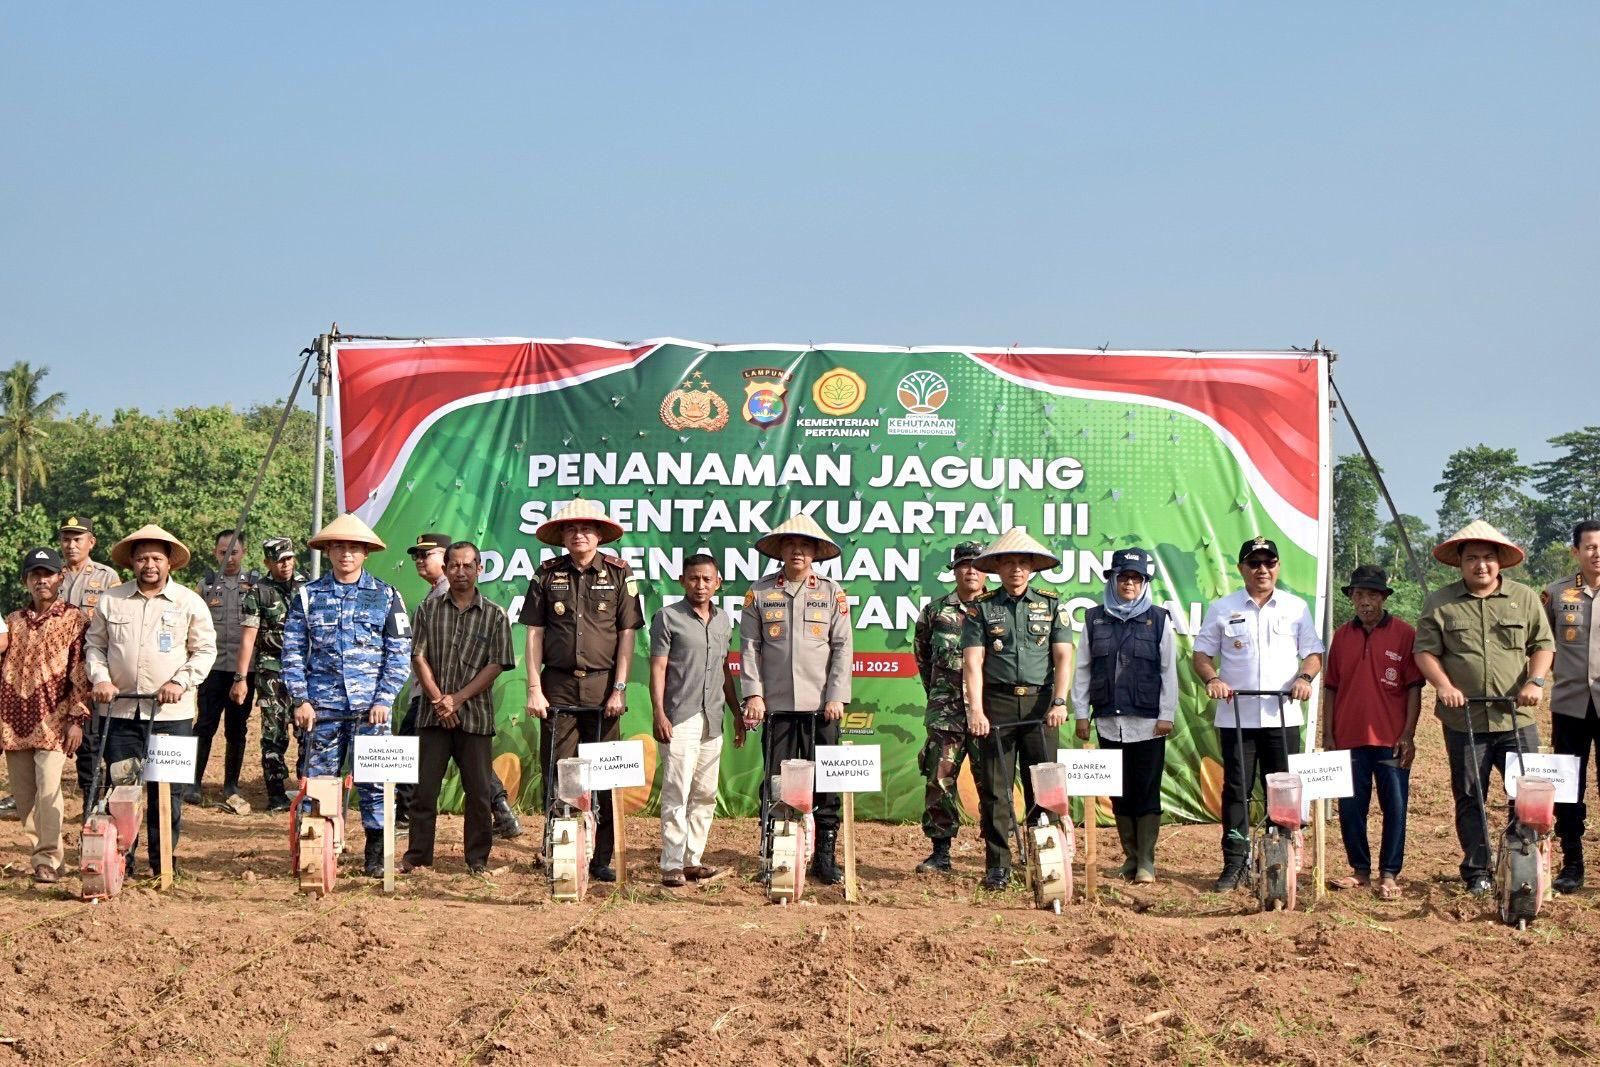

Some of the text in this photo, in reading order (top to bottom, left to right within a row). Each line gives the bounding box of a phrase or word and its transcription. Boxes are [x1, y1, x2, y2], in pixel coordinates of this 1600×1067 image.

[744, 369, 789, 380] LAMPUN
[796, 418, 879, 427] KEMENTERIAN
[889, 419, 954, 428] KEHUTANAN
[804, 428, 870, 437] PERTANIAN
[527, 452, 1084, 490] PENANAMAN JAGUNG
[1043, 502, 1088, 536] III
[866, 661, 899, 672] 2025
[599, 755, 623, 763] KAJATI
[820, 759, 875, 767] WAKAPOLDA
[604, 762, 640, 771] LAMPUNG
[826, 769, 870, 778] LAMPUNG
[1067, 772, 1112, 780] 043 GATAM
